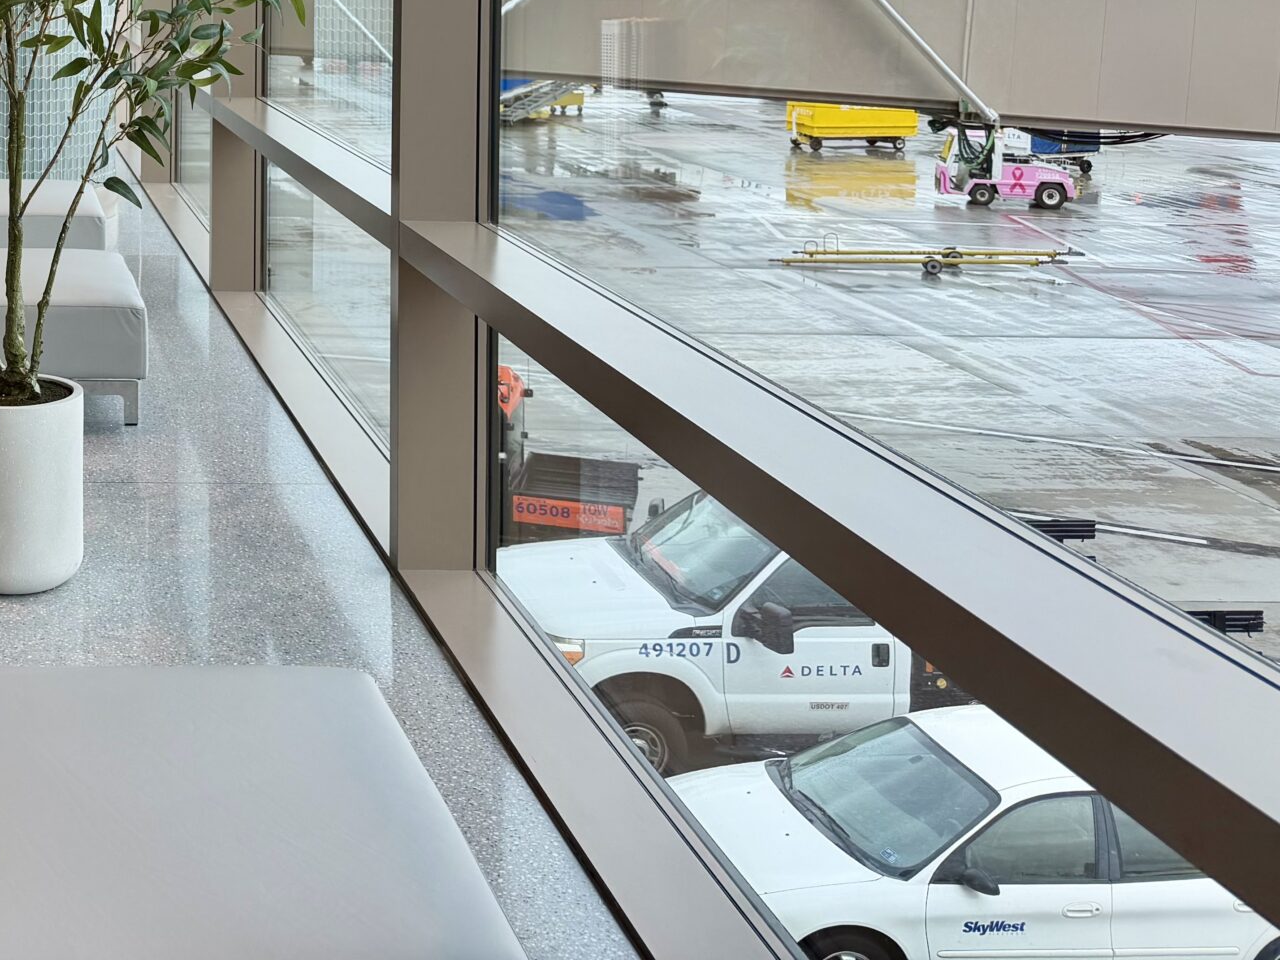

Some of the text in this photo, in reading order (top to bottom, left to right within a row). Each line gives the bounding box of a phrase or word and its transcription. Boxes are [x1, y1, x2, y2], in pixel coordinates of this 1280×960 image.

[515, 501, 571, 519] 60508
[638, 642, 742, 664] 491207 D
[800, 665, 863, 677] DELTA
[962, 920, 1026, 936] SkyWest
